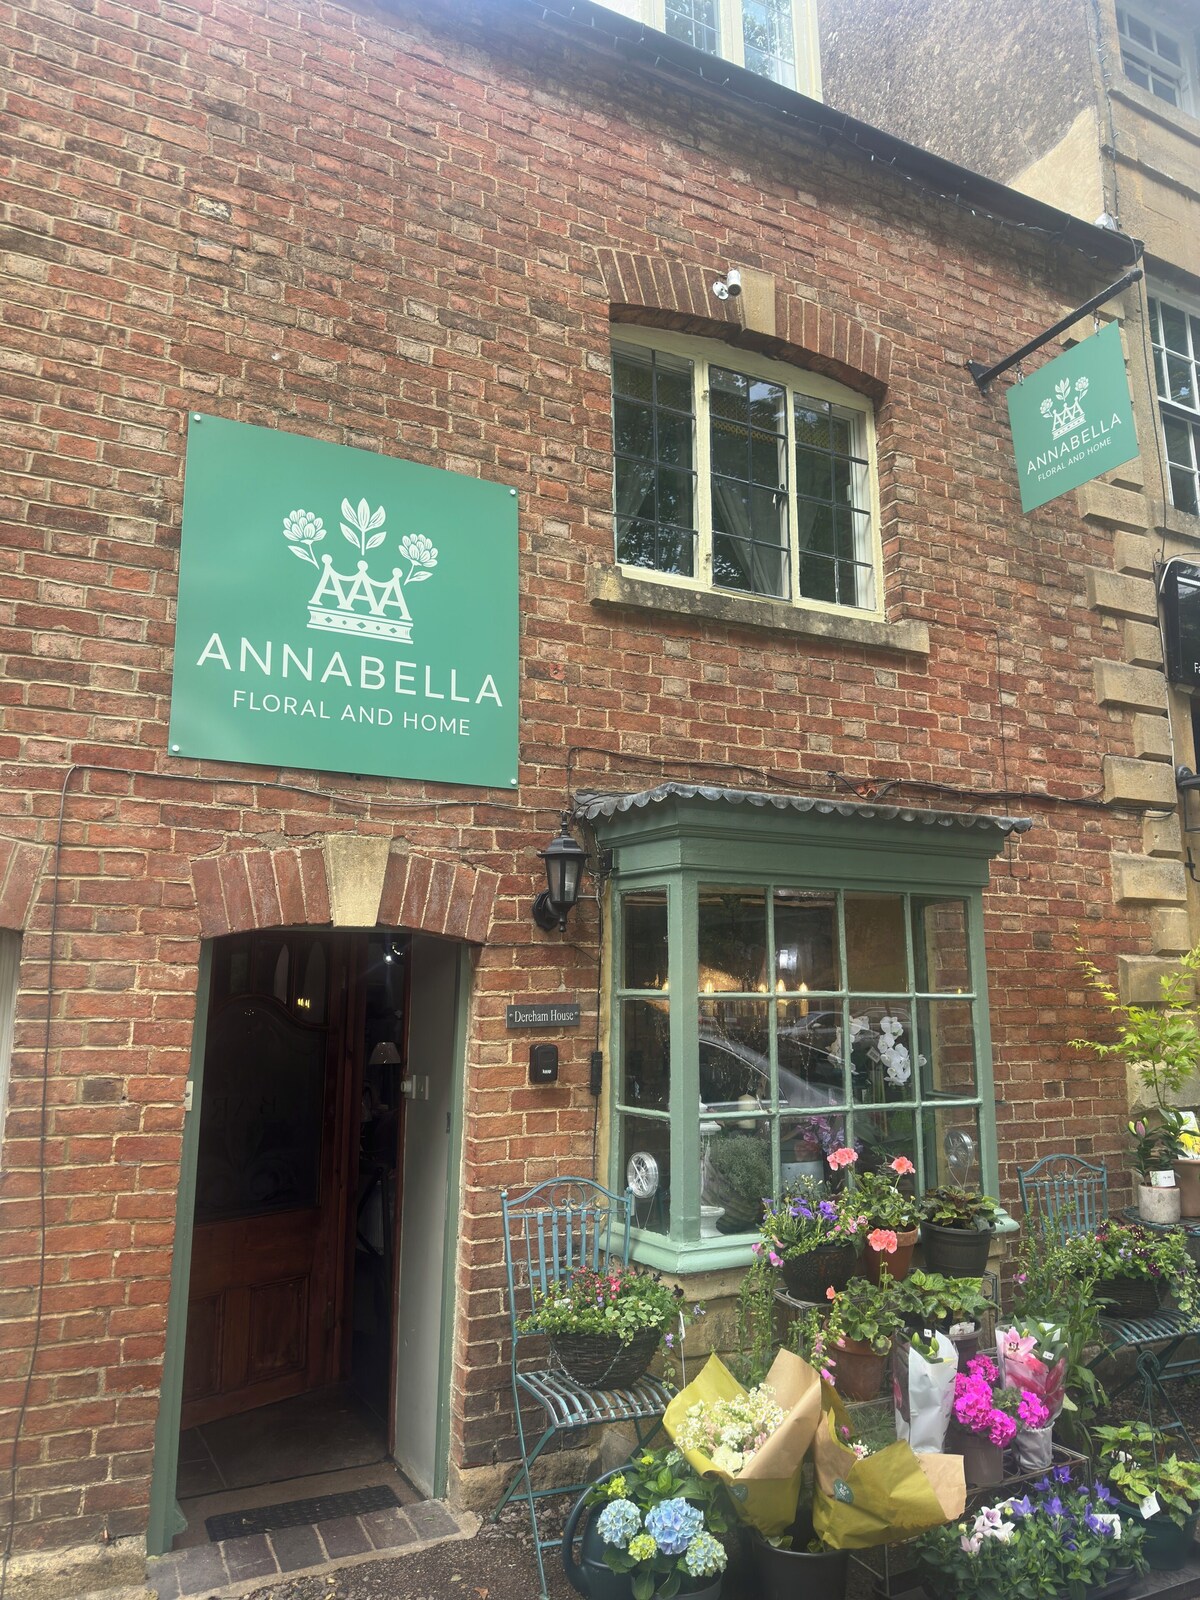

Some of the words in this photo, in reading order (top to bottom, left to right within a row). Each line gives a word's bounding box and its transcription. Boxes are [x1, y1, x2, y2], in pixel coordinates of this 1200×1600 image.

[1026, 412, 1122, 475] ANNABELLA
[1037, 464, 1066, 482] FLORAL
[1068, 452, 1085, 465] AND
[1087, 436, 1112, 455] HOME
[196, 632, 503, 707] ANNABELLA
[233, 690, 331, 720] FLORAL
[340, 704, 394, 726] AND
[403, 711, 471, 736] HOME
[514, 1010, 549, 1022] Dereham
[550, 1009, 574, 1021] House
